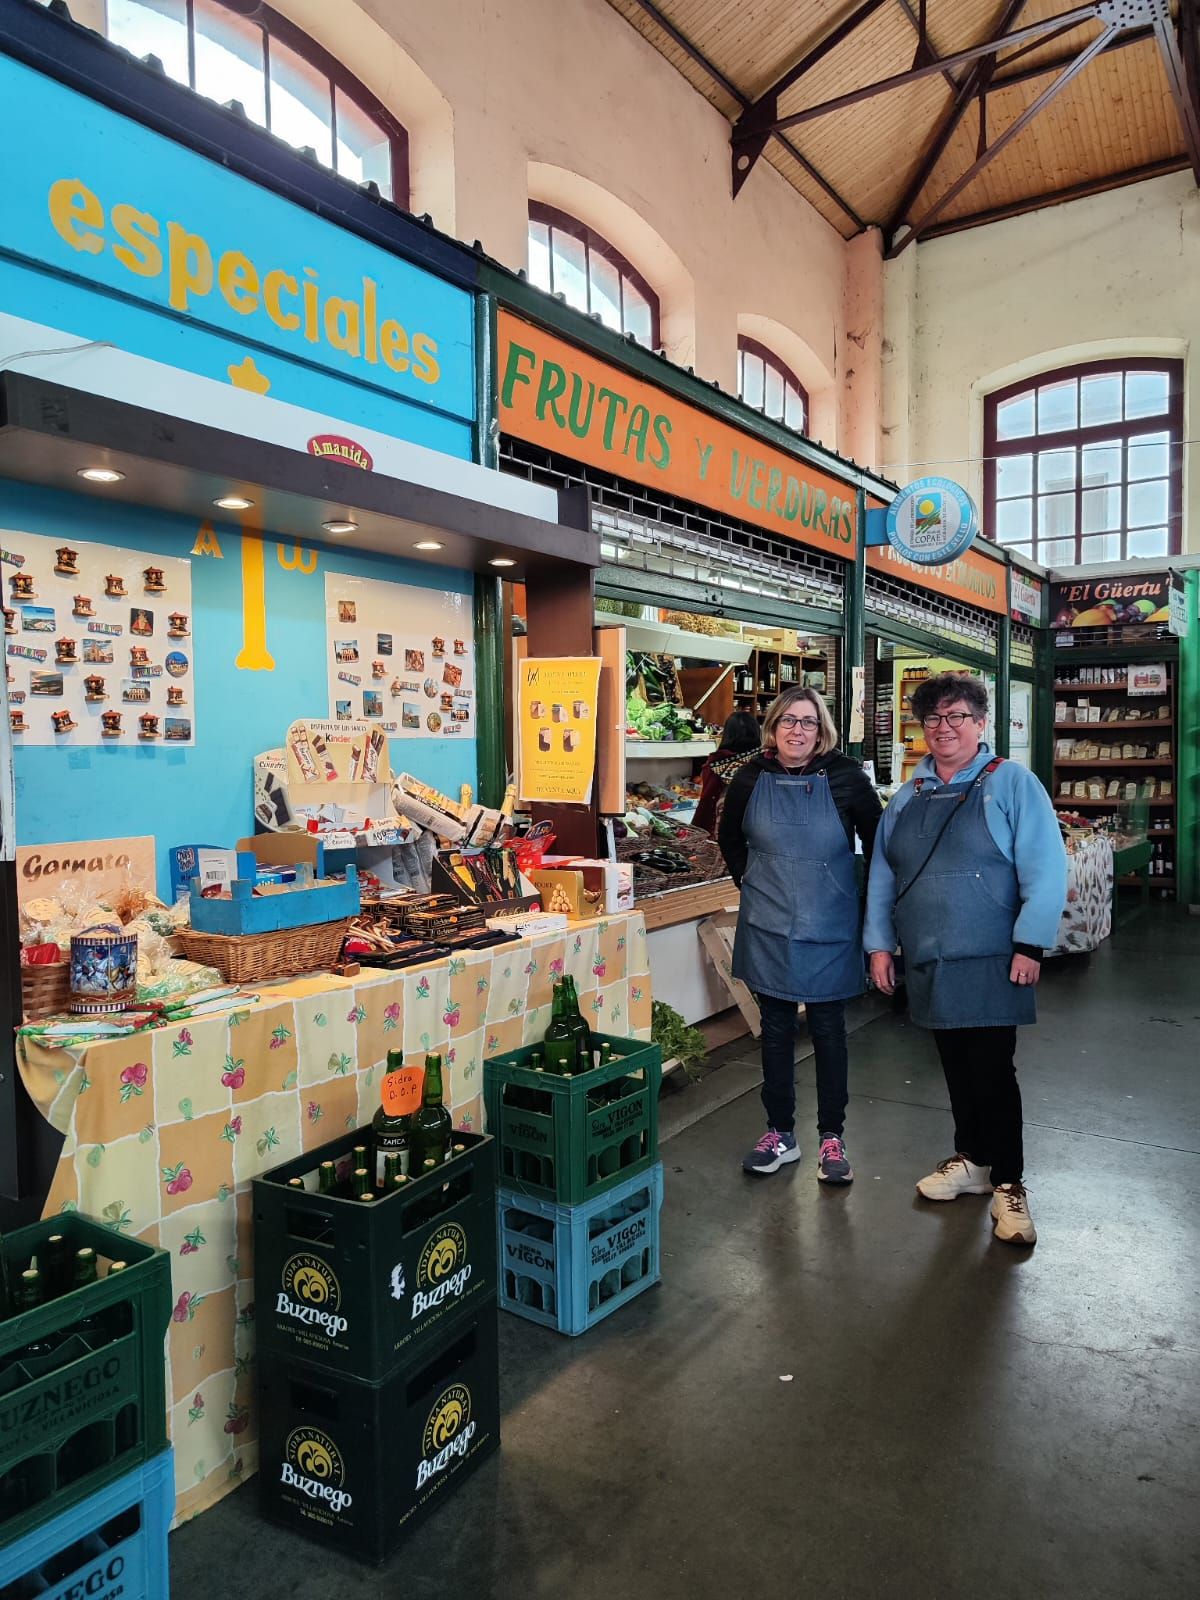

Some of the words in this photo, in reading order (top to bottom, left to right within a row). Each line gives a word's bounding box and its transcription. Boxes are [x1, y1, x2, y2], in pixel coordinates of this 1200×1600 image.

[48, 177, 442, 386] especiales
[311, 439, 369, 470] Amanida
[501, 340, 673, 471] FRUTAS
[694, 437, 715, 481] Y
[729, 447, 853, 545] VERDURAS
[325, 732, 352, 743] Kinder
[387, 1073, 413, 1088] Sidra
[608, 1098, 643, 1123] VIGON
[508, 1123, 548, 1144] VIGON
[419, 1240, 437, 1283] SIDRA
[436, 1226, 464, 1256] NATURAL
[606, 1217, 646, 1249] VIGON
[285, 1258, 304, 1289] SIDRA
[303, 1257, 337, 1299] NATURAL
[506, 1243, 555, 1273] VIGON
[410, 1263, 472, 1321] Buznego
[275, 1292, 348, 1338] Buznego
[424, 1406, 441, 1449] SIDRA
[440, 1388, 469, 1416] NATURAL
[288, 1431, 307, 1461] SIDRA
[307, 1430, 341, 1474] NATURAL
[414, 1420, 477, 1491] Buznego
[279, 1462, 353, 1513] Buznego
